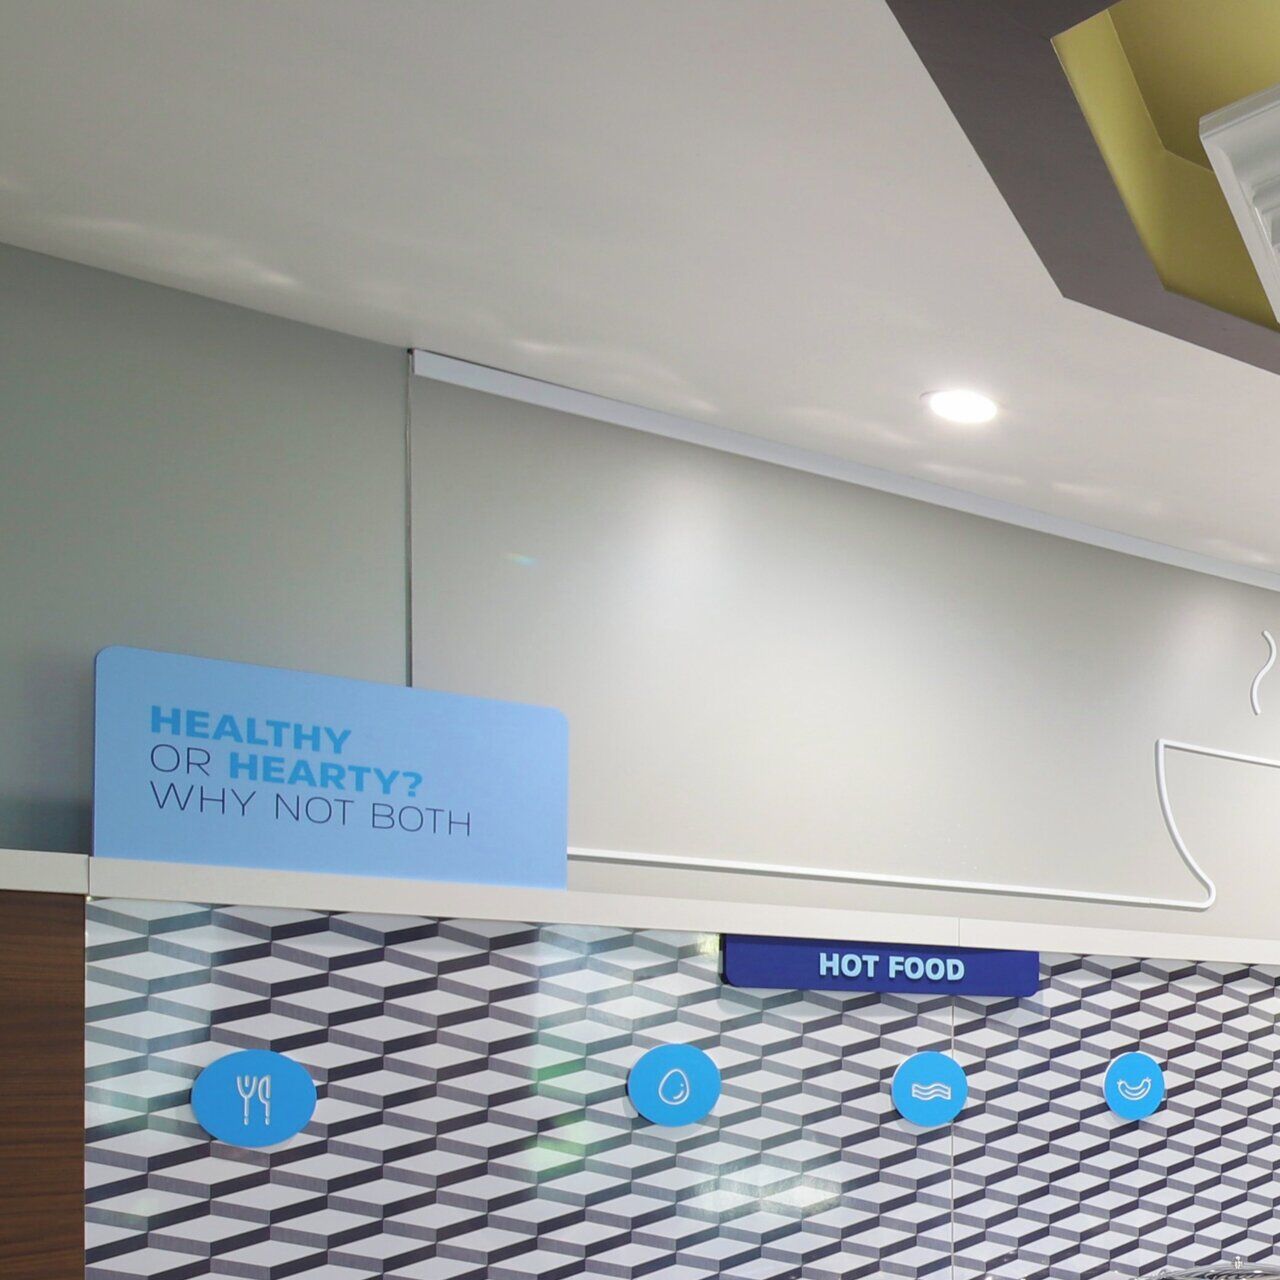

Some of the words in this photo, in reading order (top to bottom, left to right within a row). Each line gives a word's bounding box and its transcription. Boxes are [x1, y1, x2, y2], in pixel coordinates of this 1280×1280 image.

[150, 705, 352, 755] HEALTHY
[150, 743, 212, 777] OR
[228, 751, 424, 798] HEARTY?
[149, 780, 257, 816] WHY
[274, 792, 355, 827] NOT
[371, 802, 472, 837] BOTH
[819, 952, 880, 978] HOT
[888, 955, 966, 982] FOOD
